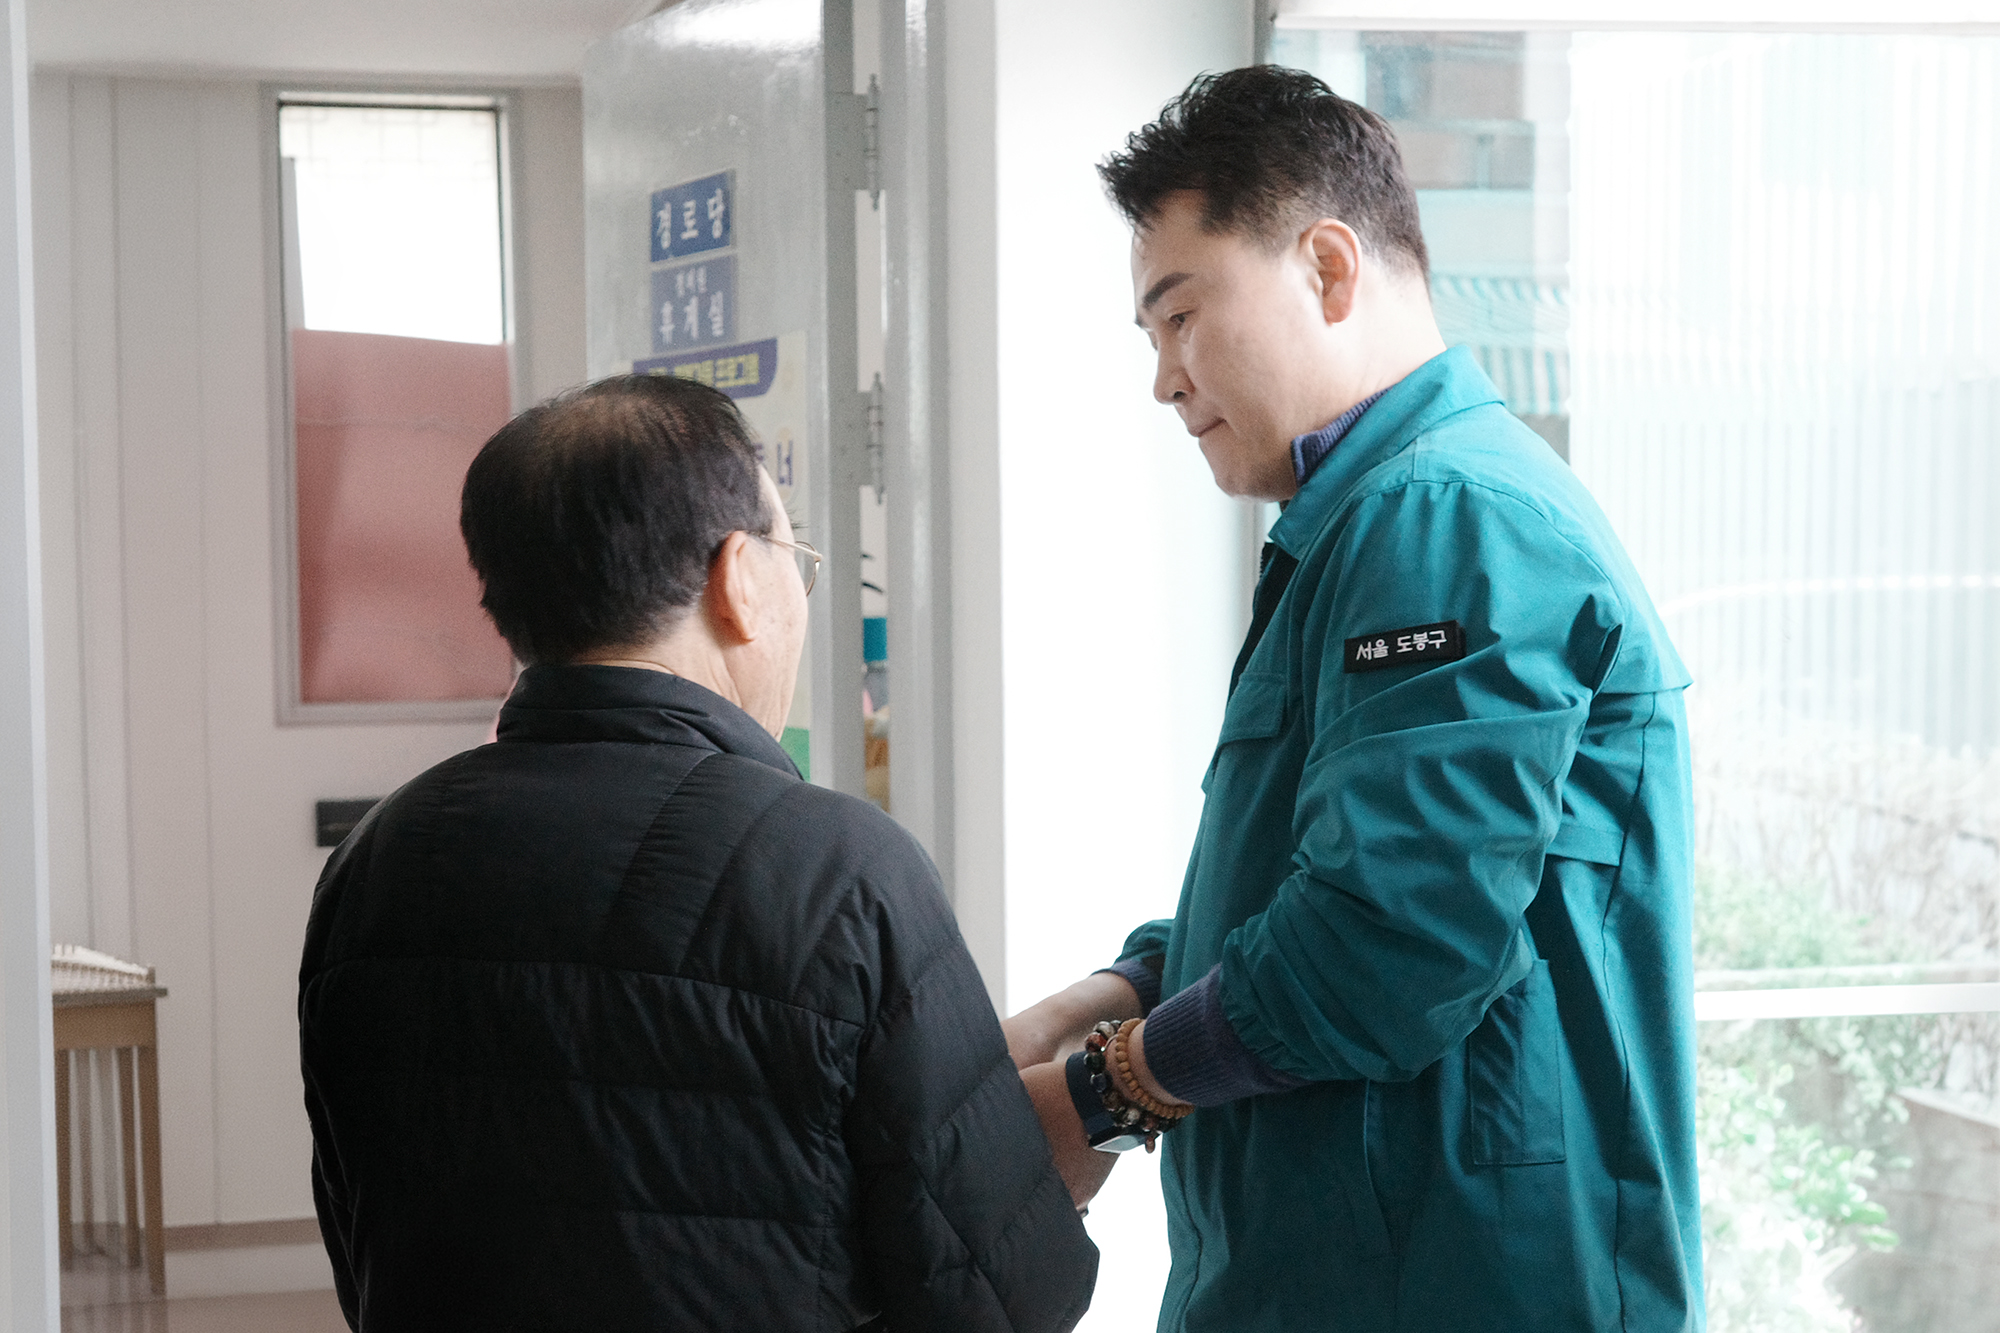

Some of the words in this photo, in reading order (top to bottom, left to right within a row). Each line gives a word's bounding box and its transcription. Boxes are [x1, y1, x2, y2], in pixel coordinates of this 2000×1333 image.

[656, 187, 725, 250] 경로당
[658, 290, 725, 344] 휴게실
[1355, 638, 1390, 661] 서울
[1396, 629, 1448, 653] 도봉구
